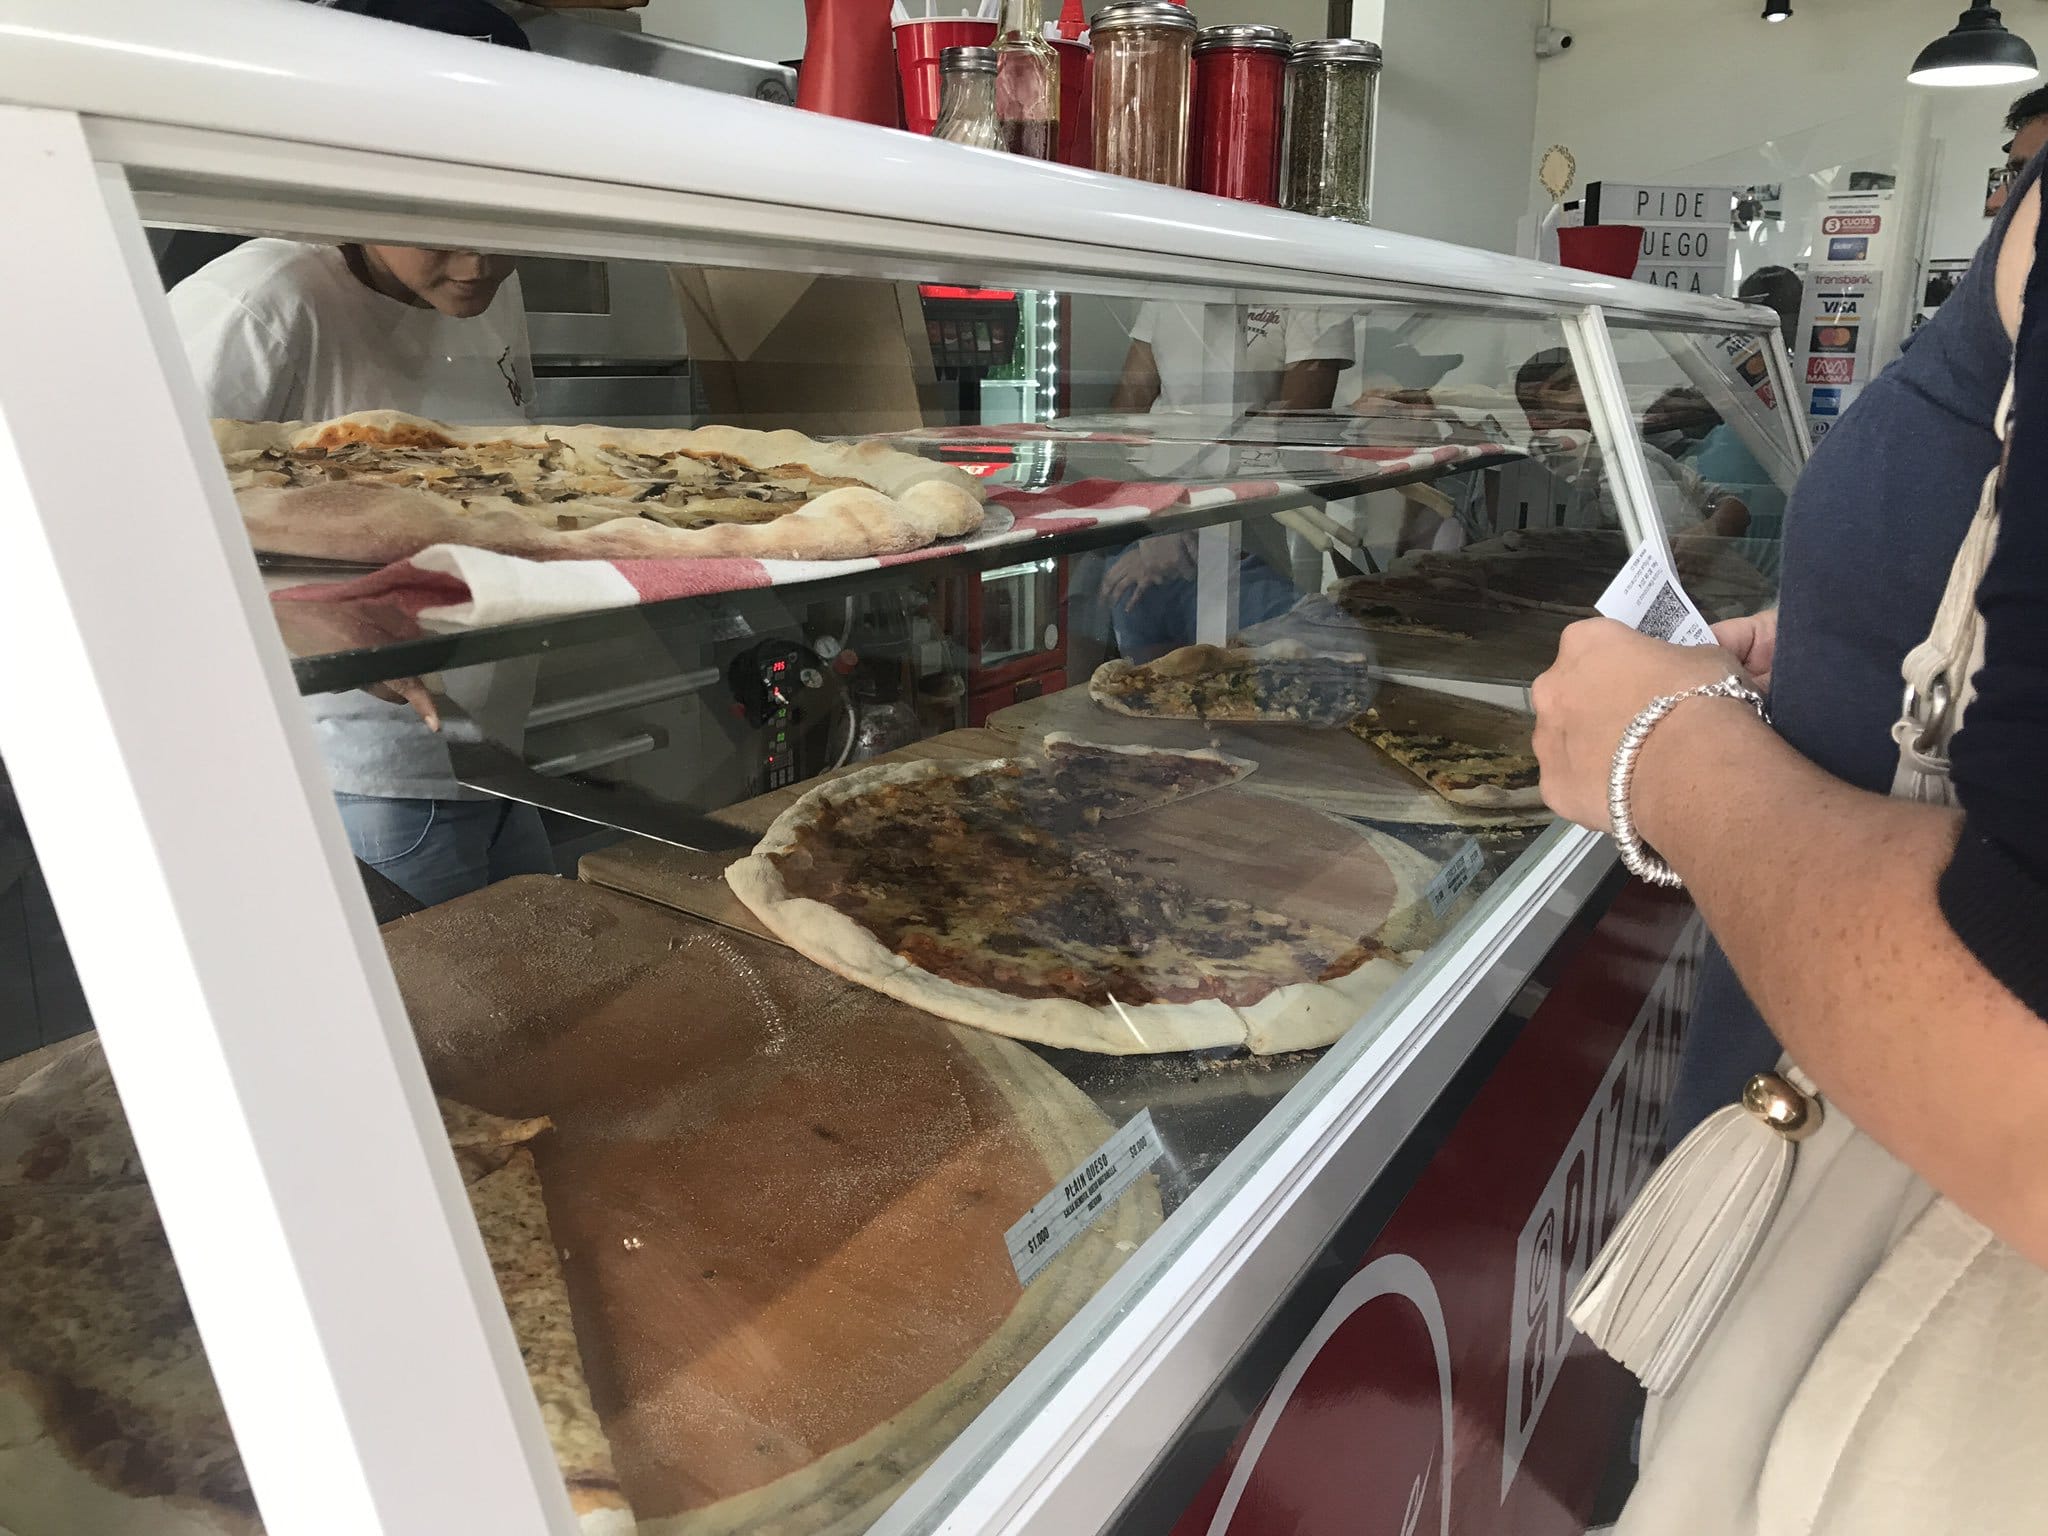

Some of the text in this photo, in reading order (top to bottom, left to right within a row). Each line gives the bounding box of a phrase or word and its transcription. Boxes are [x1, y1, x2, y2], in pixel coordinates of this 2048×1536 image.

[1637, 190, 1704, 218] PIDE
[1643, 231, 1709, 258] UEGO
[1649, 270, 1701, 294] AGA
[1823, 300, 1857, 314] VISA
[1064, 1172, 1087, 1202] PLAIN
[1086, 1153, 1109, 1182] QUESO
[1028, 1226, 1050, 1255] $1.000
